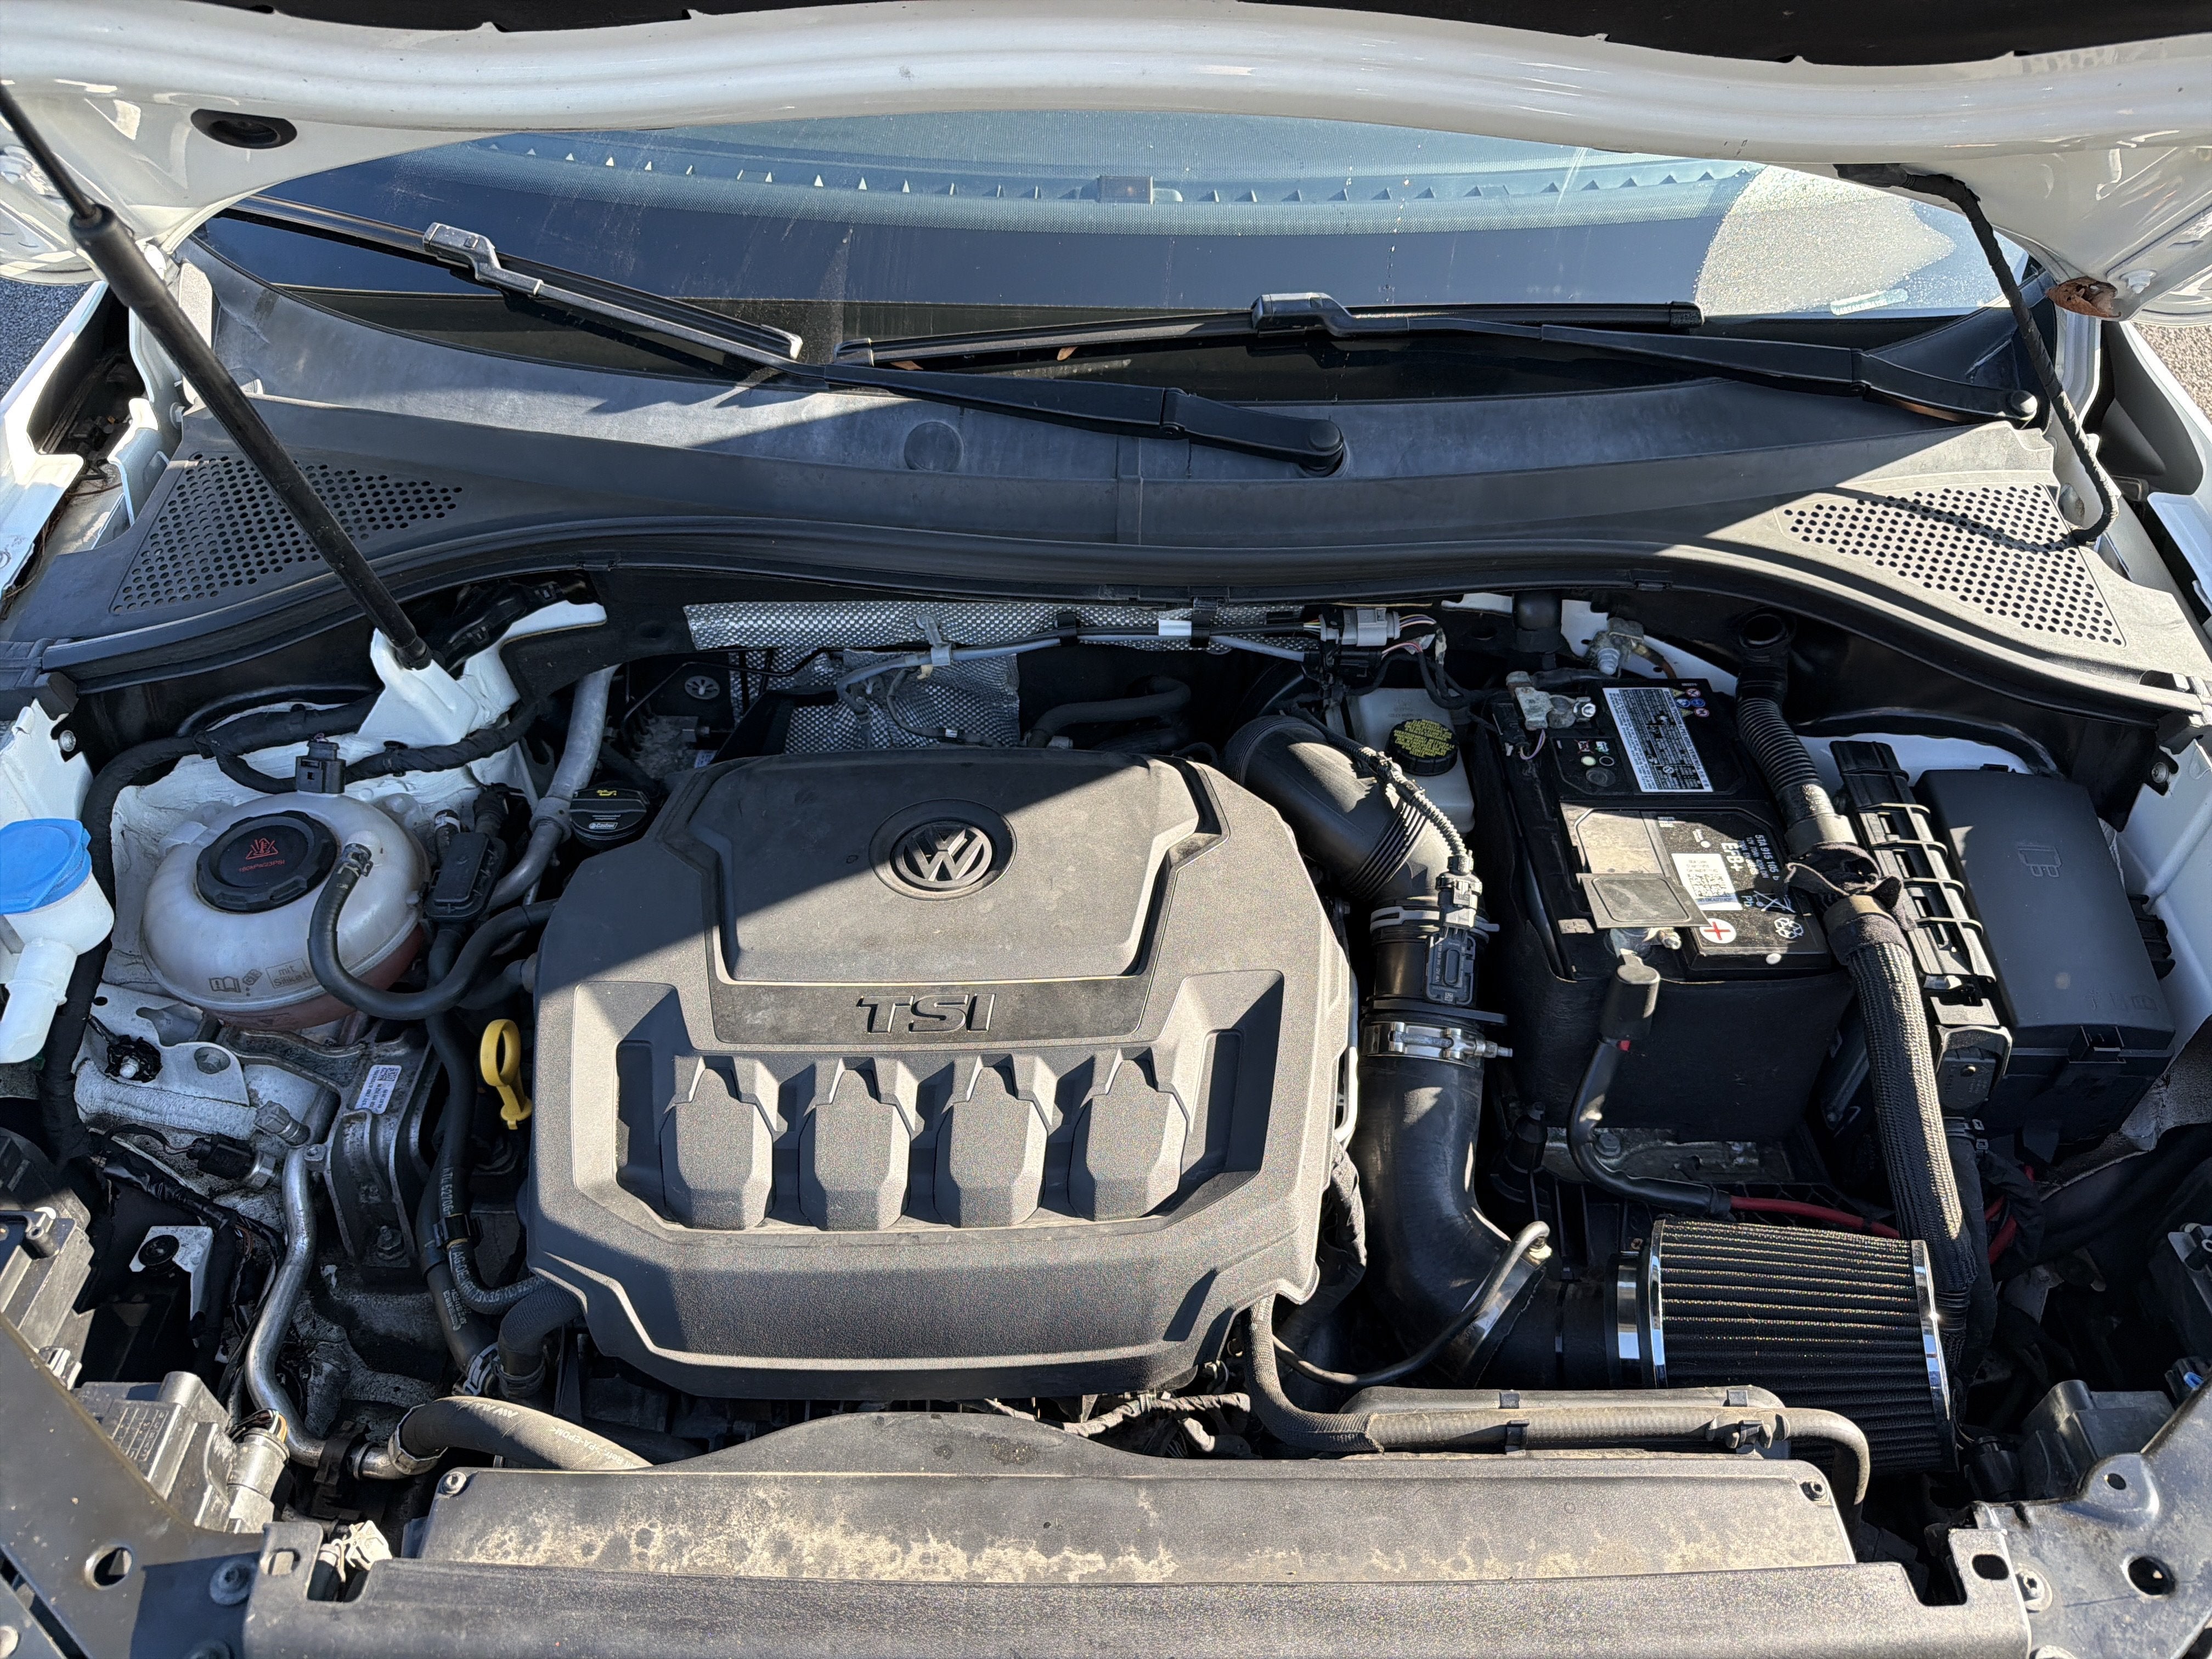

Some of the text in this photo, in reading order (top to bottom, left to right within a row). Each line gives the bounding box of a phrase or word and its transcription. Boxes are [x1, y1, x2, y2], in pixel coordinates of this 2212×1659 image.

[1755, 834, 1768, 847] 5TA
[1721, 843, 1745, 872] EFB+
[1760, 847, 1774, 860] 915
[1767, 861, 1780, 873] 105
[1741, 896, 1754, 907] Pb
[279, 964, 295, 975] mit
[273, 971, 309, 987] Silikat
[856, 992, 997, 1035] TSI
